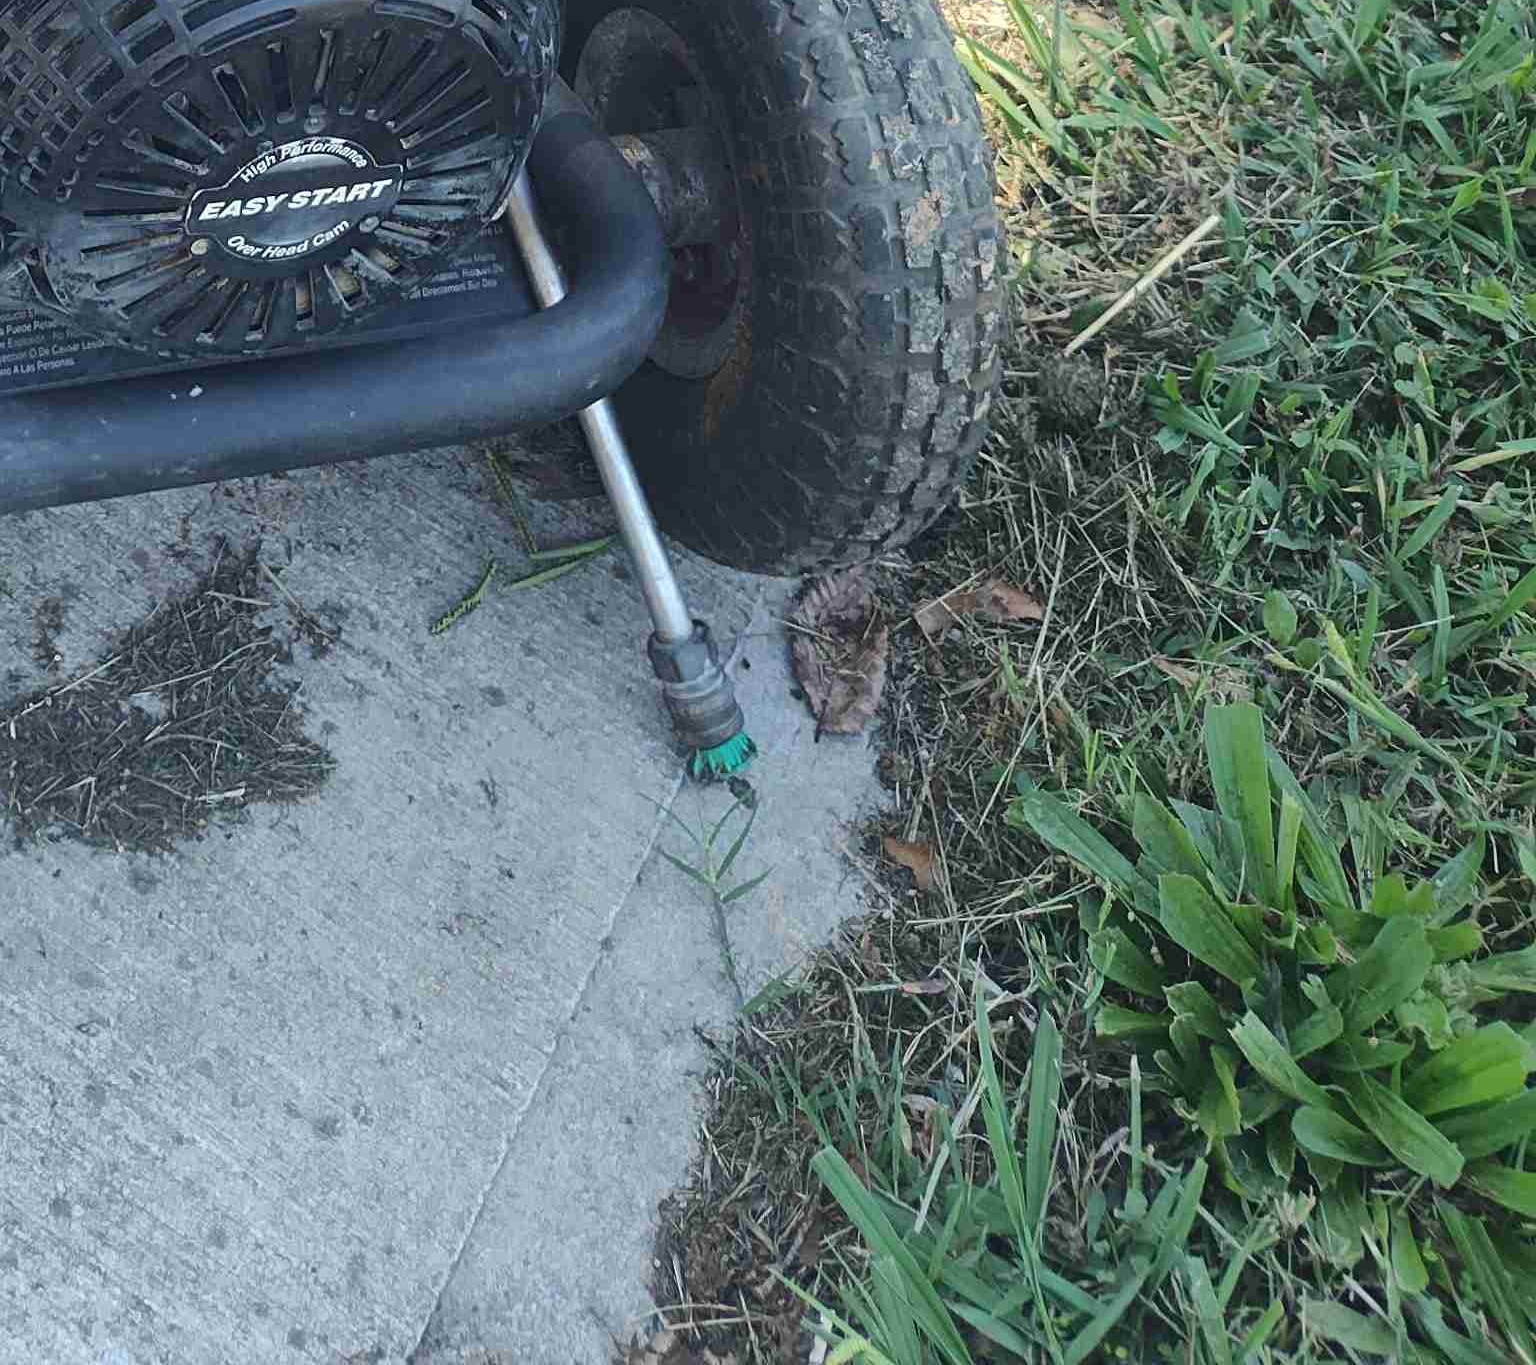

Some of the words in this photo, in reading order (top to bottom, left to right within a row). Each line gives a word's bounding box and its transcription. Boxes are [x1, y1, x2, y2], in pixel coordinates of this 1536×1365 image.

[239, 154, 277, 183] High
[279, 140, 368, 168] Performance
[198, 193, 289, 221] EASY
[288, 179, 393, 209] START
[227, 235, 264, 258] Over
[263, 239, 309, 258] Head
[313, 220, 350, 246] Cam
